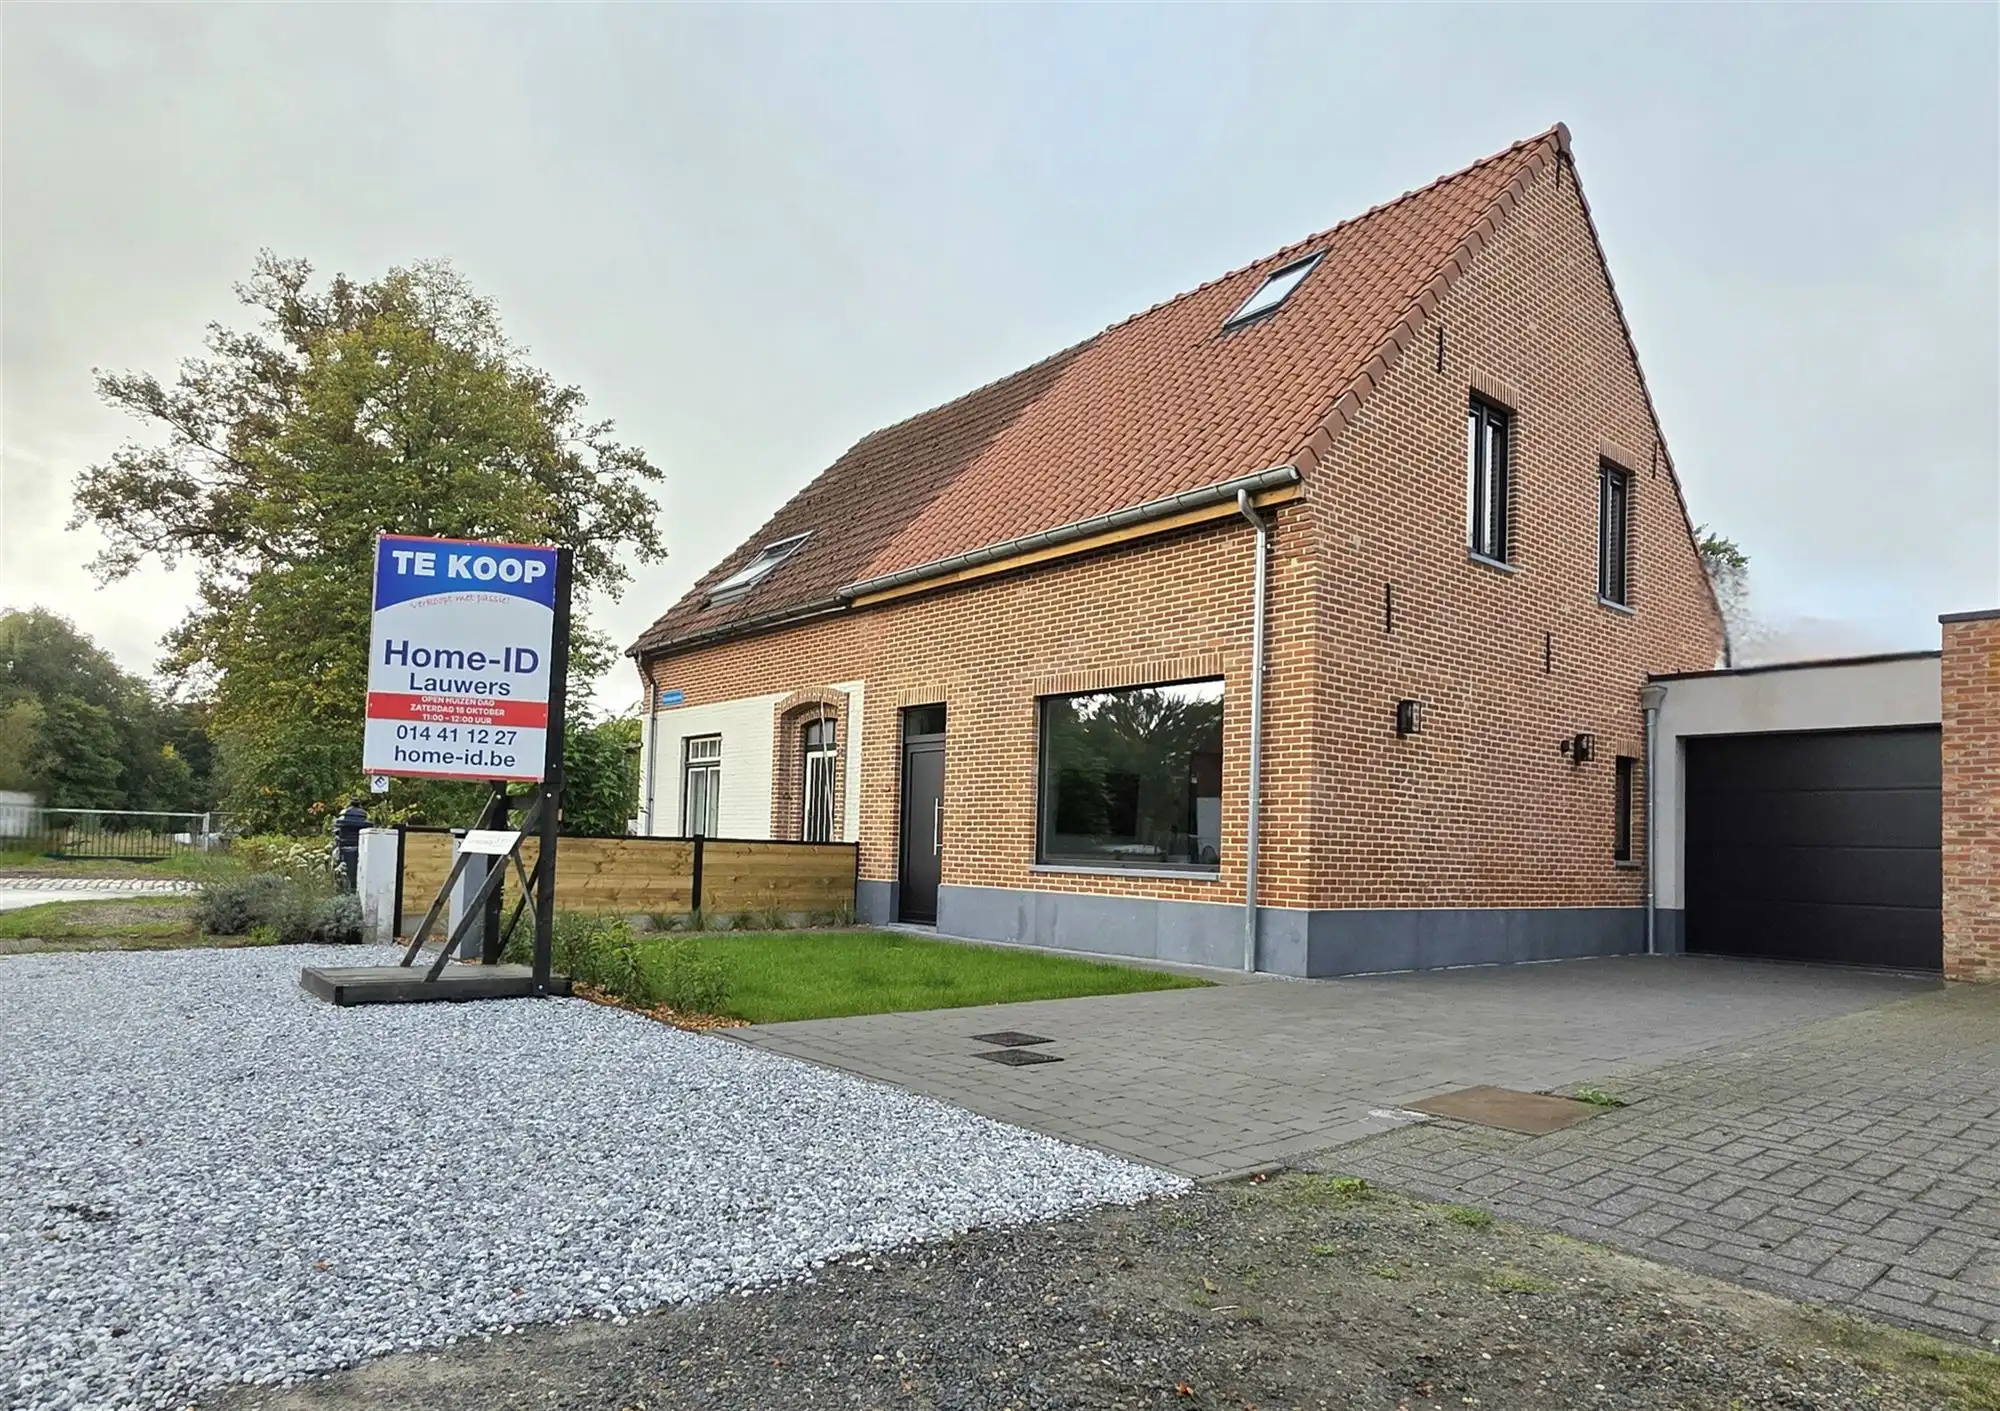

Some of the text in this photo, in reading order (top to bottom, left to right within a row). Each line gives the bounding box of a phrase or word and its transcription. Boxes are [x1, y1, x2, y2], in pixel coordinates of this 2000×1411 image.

[392, 550, 546, 584] TE KOOP
[384, 639, 539, 674] Home-ID
[409, 672, 511, 696] Lauwers
[421, 695, 445, 703] OPEN
[446, 697, 476, 706] HUIZEN
[422, 713, 444, 721] 11:00
[451, 715, 473, 723] 12:00
[466, 707, 505, 717] OKTOBER
[396, 724, 517, 746] 014 41 12 27
[394, 746, 516, 768] home-id.be
